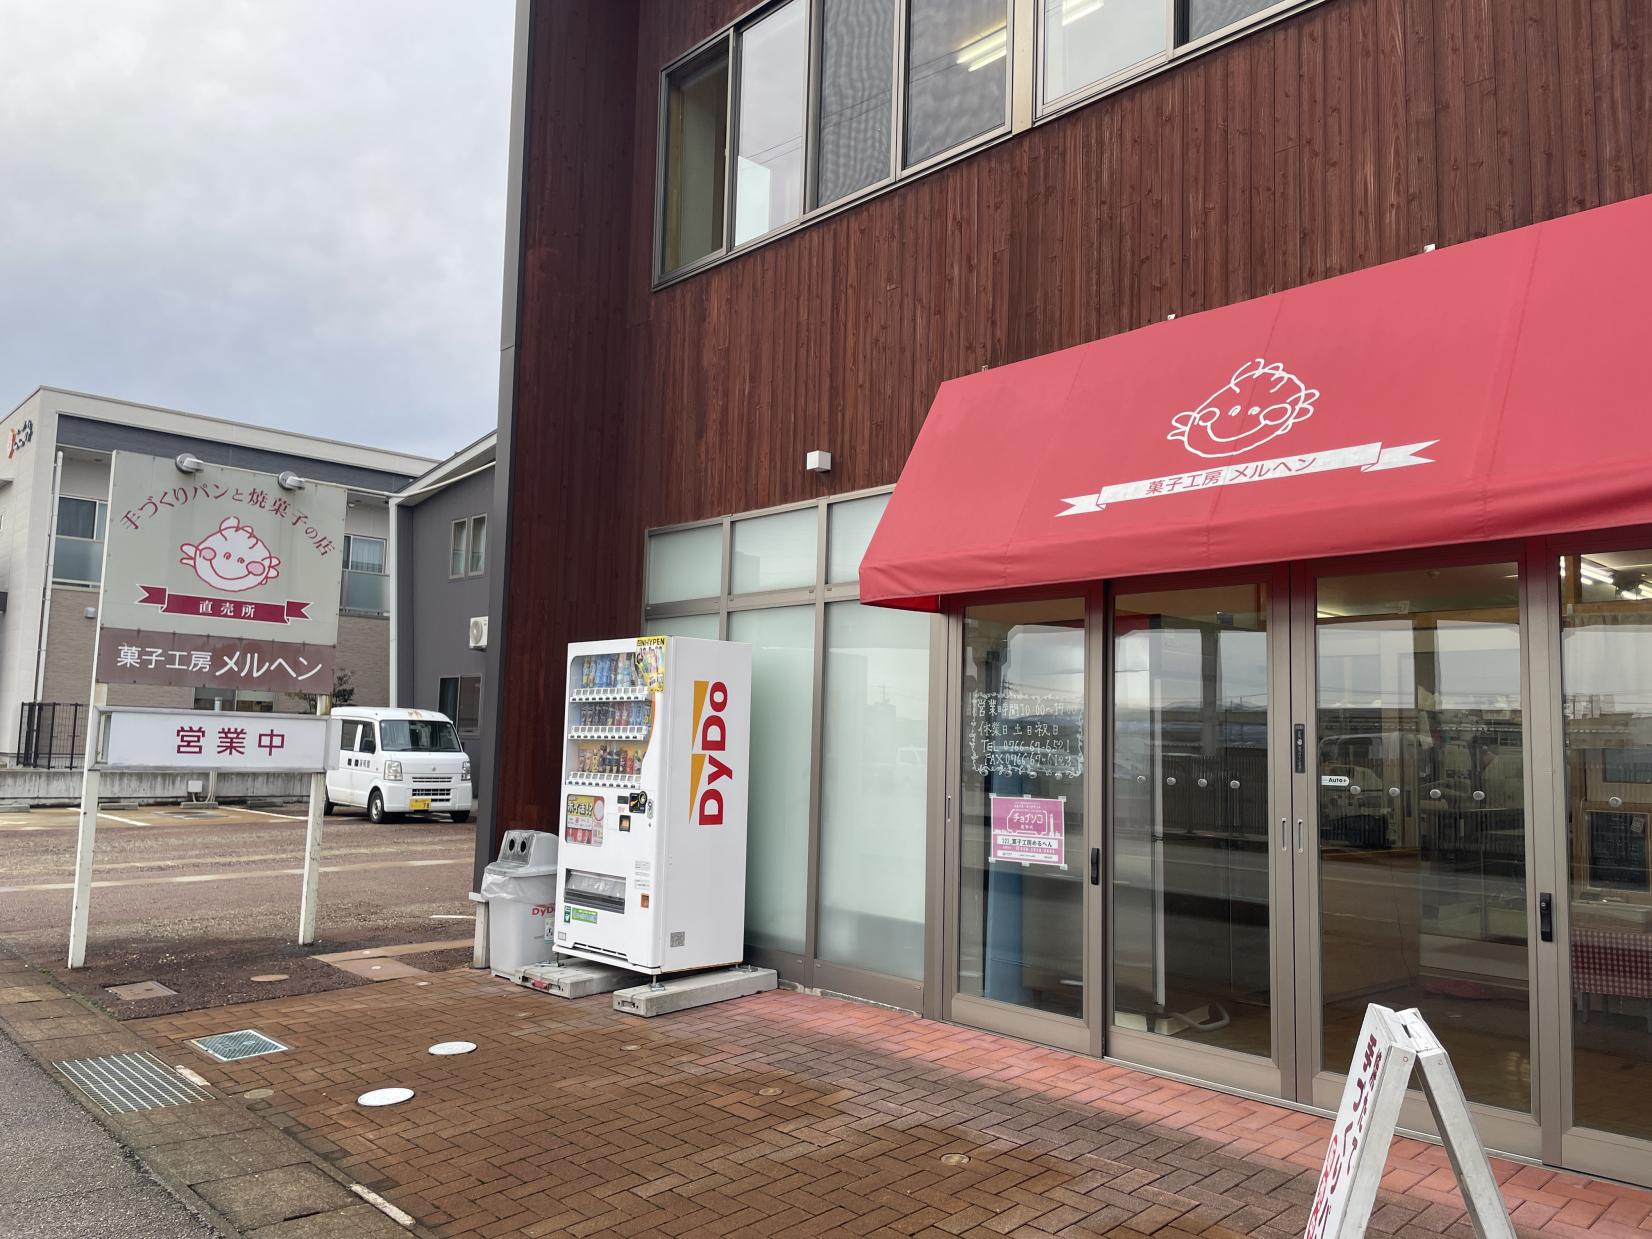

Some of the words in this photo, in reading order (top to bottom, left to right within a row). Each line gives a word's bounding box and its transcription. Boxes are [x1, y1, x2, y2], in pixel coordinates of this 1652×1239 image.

[1146, 469, 1224, 495] 菓子工房
[1229, 457, 1317, 482] メルヘン
[120, 484, 336, 557] 手づくりパンと焼菓子の店
[199, 600, 256, 618] 直売所
[636, 637, 665, 646] ENHYPEN
[117, 643, 213, 672] 菓子工房
[215, 651, 322, 680] メルヘン
[978, 721, 1008, 736] 休業日
[176, 726, 285, 756] 営業中
[981, 739, 999, 752] TEL
[699, 681, 733, 825] DyDo
[984, 753, 1004, 766] FAX
[1012, 812, 1044, 824] チョイソコ
[531, 906, 556, 917] DyD
[1314, 1033, 1377, 1239] 手づくりパ
